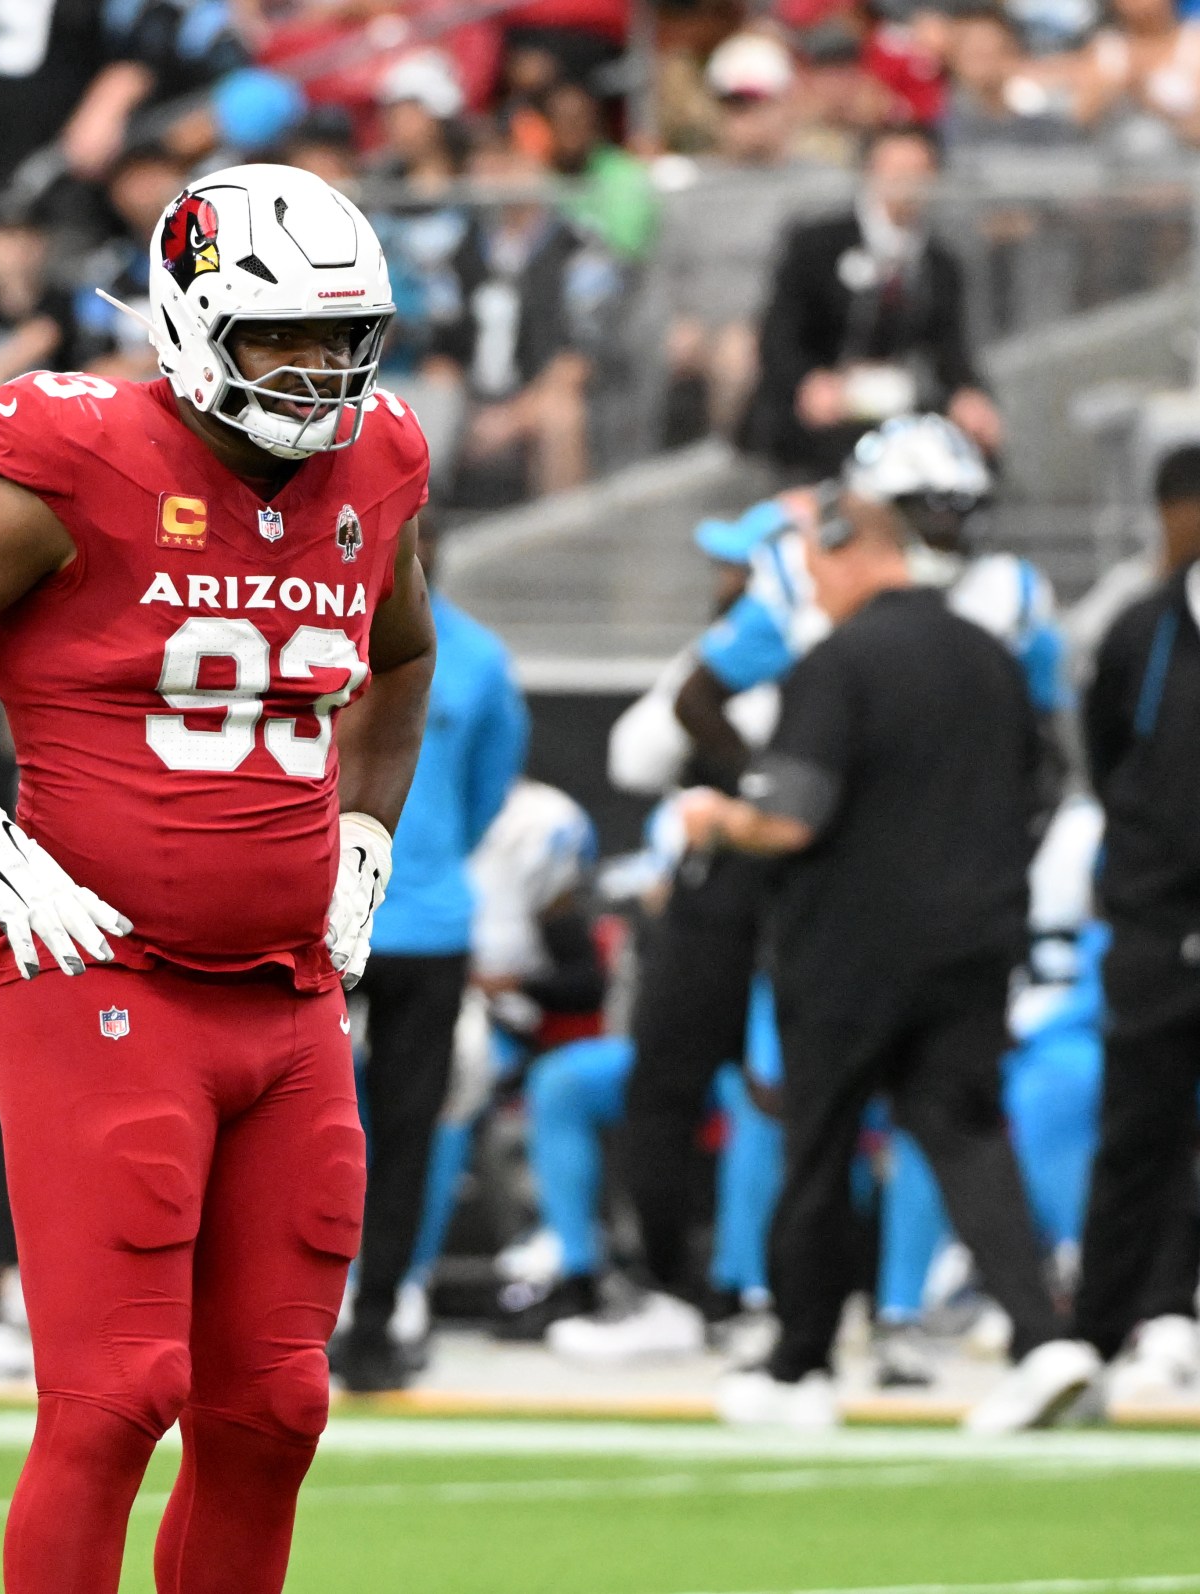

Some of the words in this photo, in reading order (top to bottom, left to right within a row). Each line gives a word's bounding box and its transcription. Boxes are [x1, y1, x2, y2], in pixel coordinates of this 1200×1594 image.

[317, 289, 366, 299] CARDINALS
[162, 496, 207, 536] C
[139, 572, 367, 617] ARIZONA
[145, 616, 369, 779] 93
